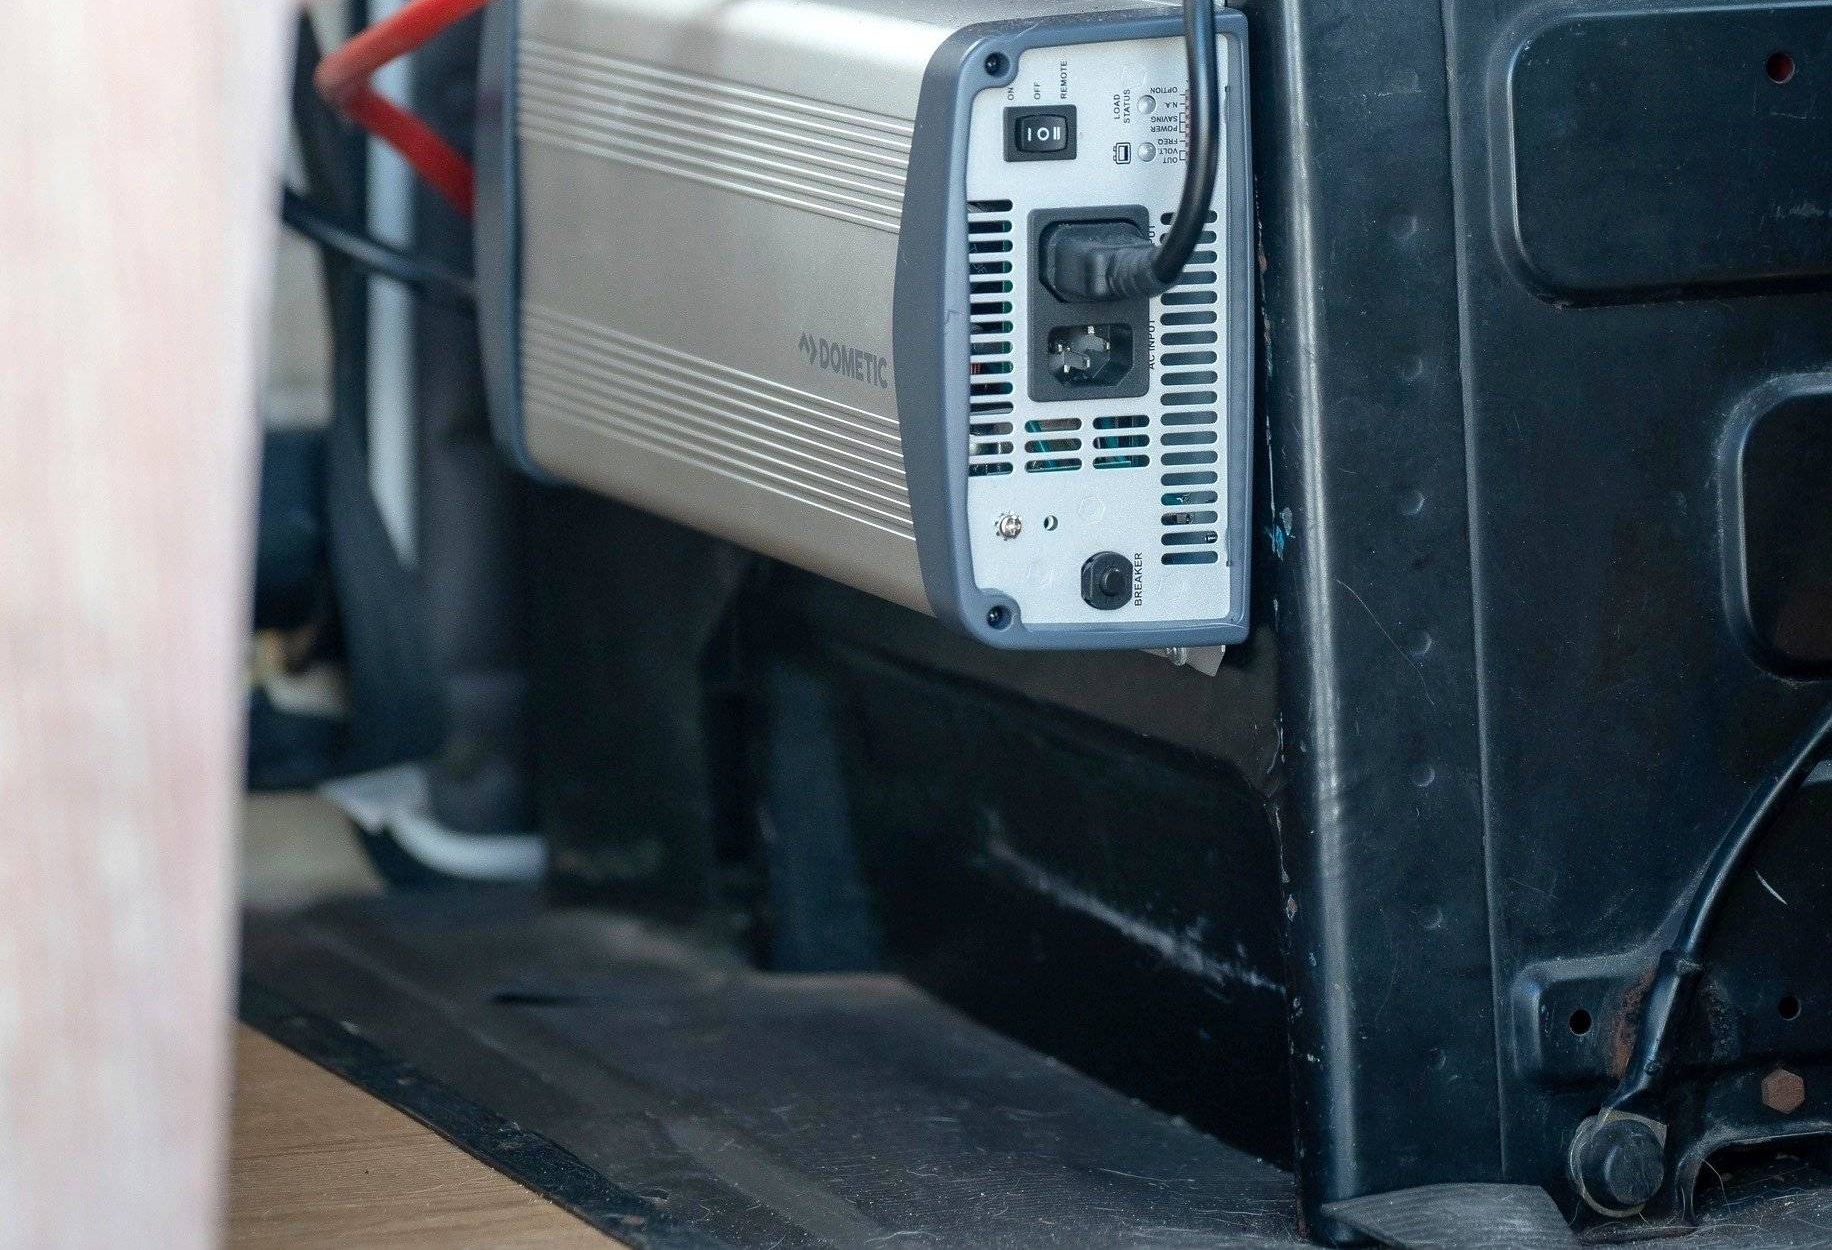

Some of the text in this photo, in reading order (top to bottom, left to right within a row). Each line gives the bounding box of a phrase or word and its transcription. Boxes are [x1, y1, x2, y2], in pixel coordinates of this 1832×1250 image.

[1008, 87, 1014, 100] ON
[1150, 86, 1178, 94] OPTION
[1123, 89, 1131, 123] STATUS
[1150, 115, 1178, 123] SAVING
[1150, 125, 1178, 133] POWER
[819, 337, 888, 389] DOMETIC
[1134, 552, 1143, 607] BREAKER
